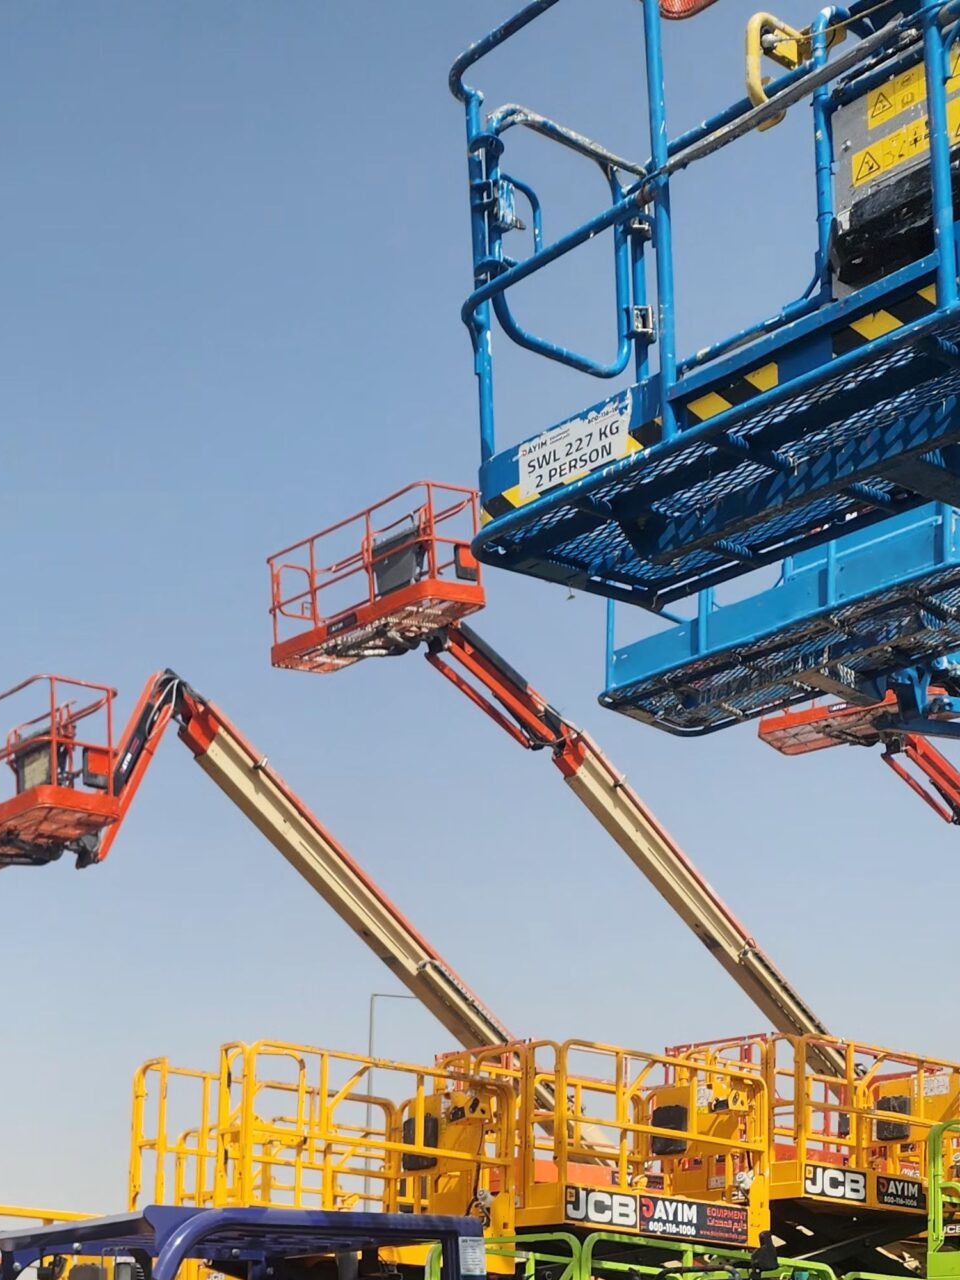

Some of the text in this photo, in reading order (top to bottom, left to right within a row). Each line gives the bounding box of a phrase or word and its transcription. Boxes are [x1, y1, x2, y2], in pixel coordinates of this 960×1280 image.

[528, 448, 560, 475] SWL
[564, 432, 593, 457] 227
[598, 420, 620, 441] KG
[535, 442, 612, 489] 2 PERSON
[805, 1166, 866, 1200] JCB
[878, 1177, 919, 1198] DAYIM
[566, 1187, 637, 1226] JCB
[640, 1197, 697, 1224] DAYIM
